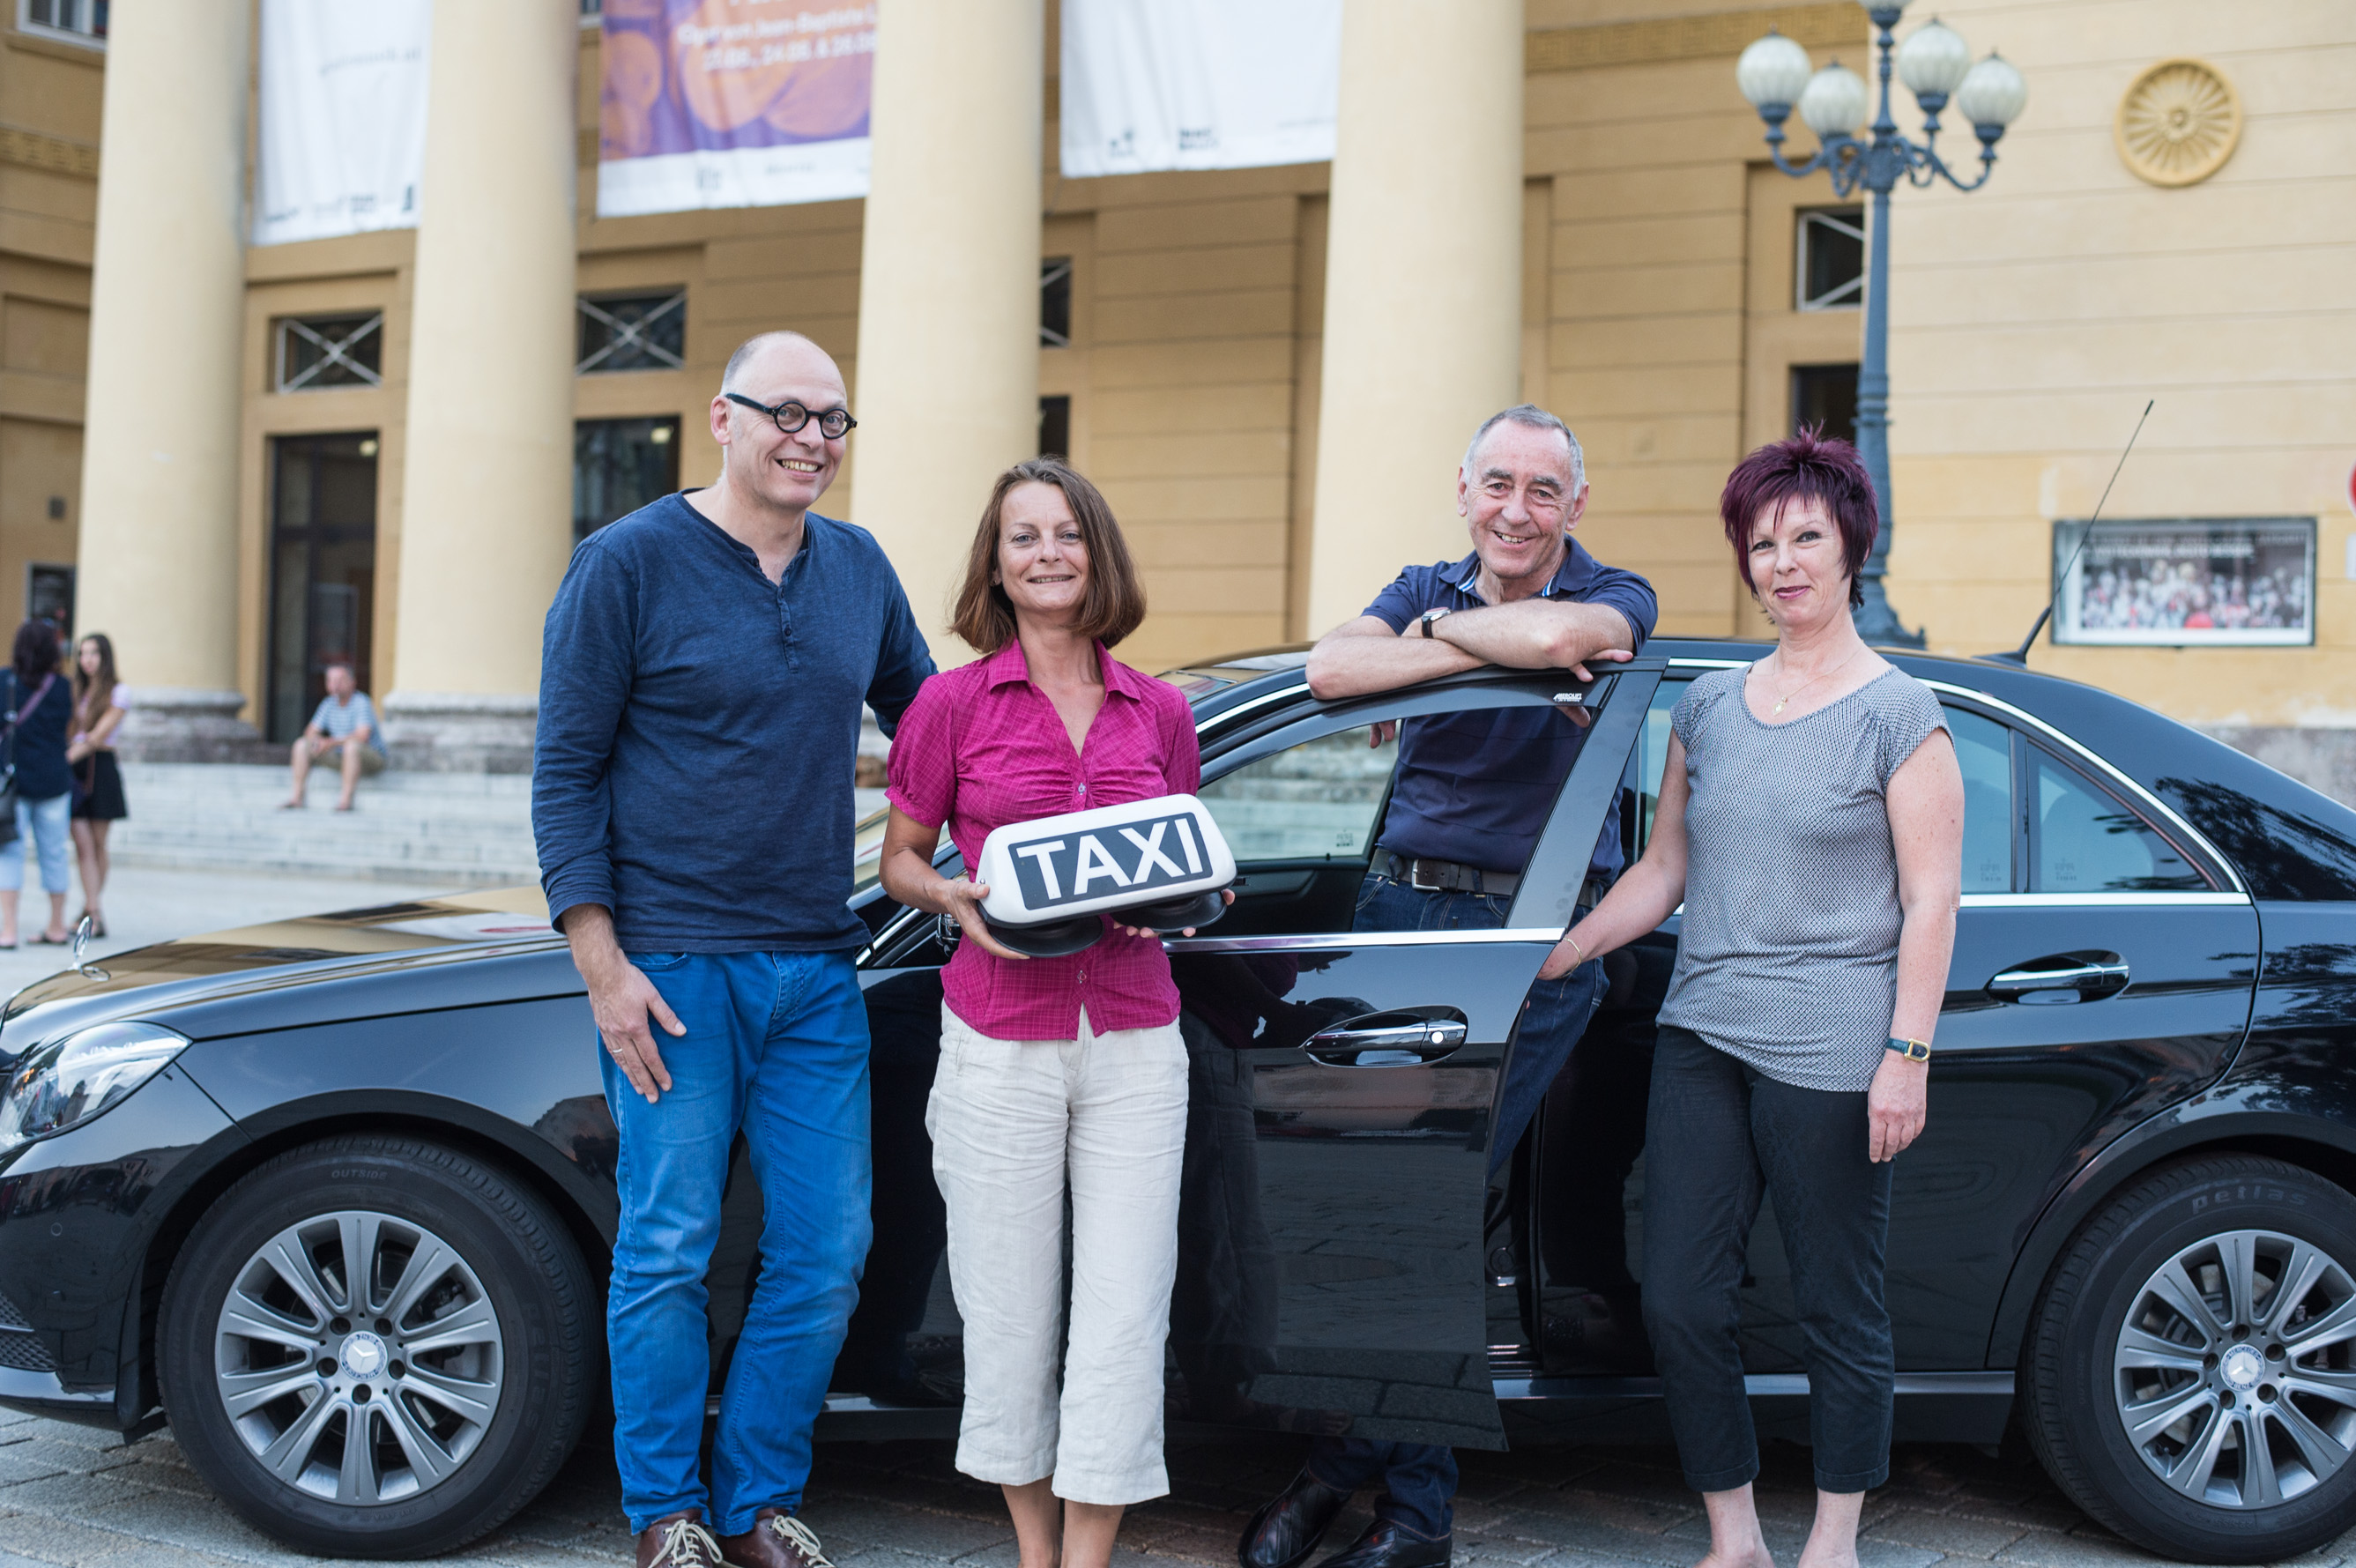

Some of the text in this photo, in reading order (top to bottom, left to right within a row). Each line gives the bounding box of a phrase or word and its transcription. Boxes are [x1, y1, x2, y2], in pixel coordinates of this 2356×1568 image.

[1016, 818, 1203, 900] TAXI
[331, 1168, 389, 1181] OUTSIDE
[2191, 1185, 2308, 1215] petlas
